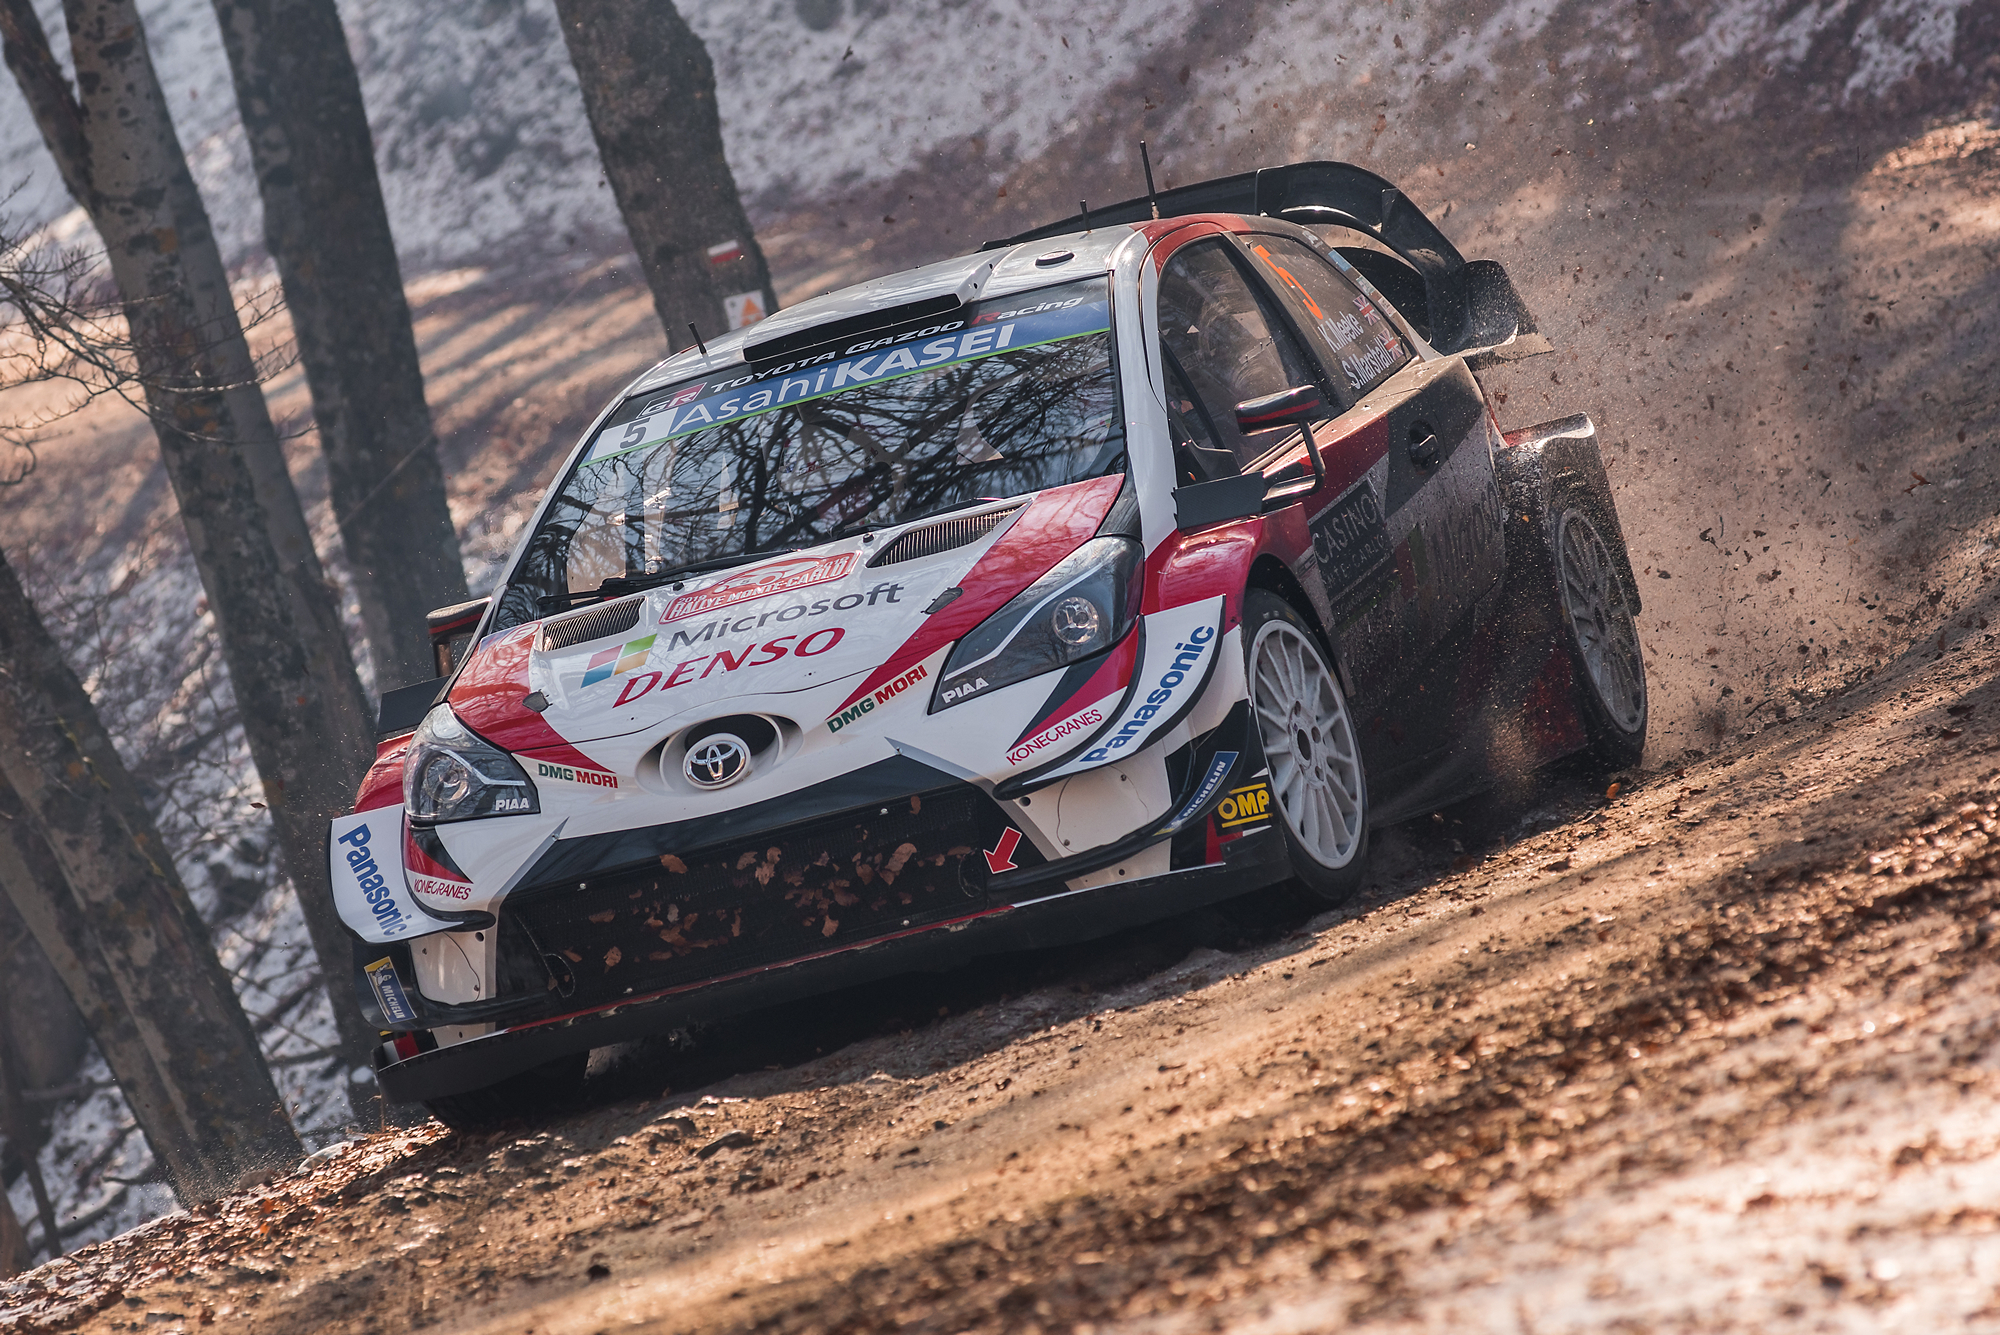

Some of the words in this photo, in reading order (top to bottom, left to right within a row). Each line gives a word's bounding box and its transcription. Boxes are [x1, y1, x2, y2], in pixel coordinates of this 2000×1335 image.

[1253, 244, 1324, 320] 5
[711, 351, 836, 393] TOYOTA
[845, 321, 965, 355] GAZOO
[972, 296, 1084, 325] Racing
[1317, 311, 1364, 353] K.Meeke
[1342, 336, 1394, 390] S.Marshall
[639, 388, 699, 418] GR
[620, 416, 650, 450] 5
[1312, 494, 1377, 564] CASINO
[667, 582, 905, 651] Microsoft
[668, 595, 726, 619] RALLYE
[612, 627, 846, 709] DENSO
[941, 677, 990, 704] PIAA
[1080, 625, 1215, 763] Panasonic
[827, 697, 875, 733] DMG
[873, 664, 929, 705] MORI
[1006, 708, 1104, 766] KONECRANES
[537, 763, 574, 781] DMG
[576, 772, 619, 789] MORI
[1182, 760, 1227, 820] MICHELIN
[495, 797, 530, 811] PIAA
[1217, 790, 1271, 821] OMP
[337, 823, 412, 937] Panasonic
[413, 879, 472, 901] KONECRANES
[381, 984, 406, 1020] MICHELIN
